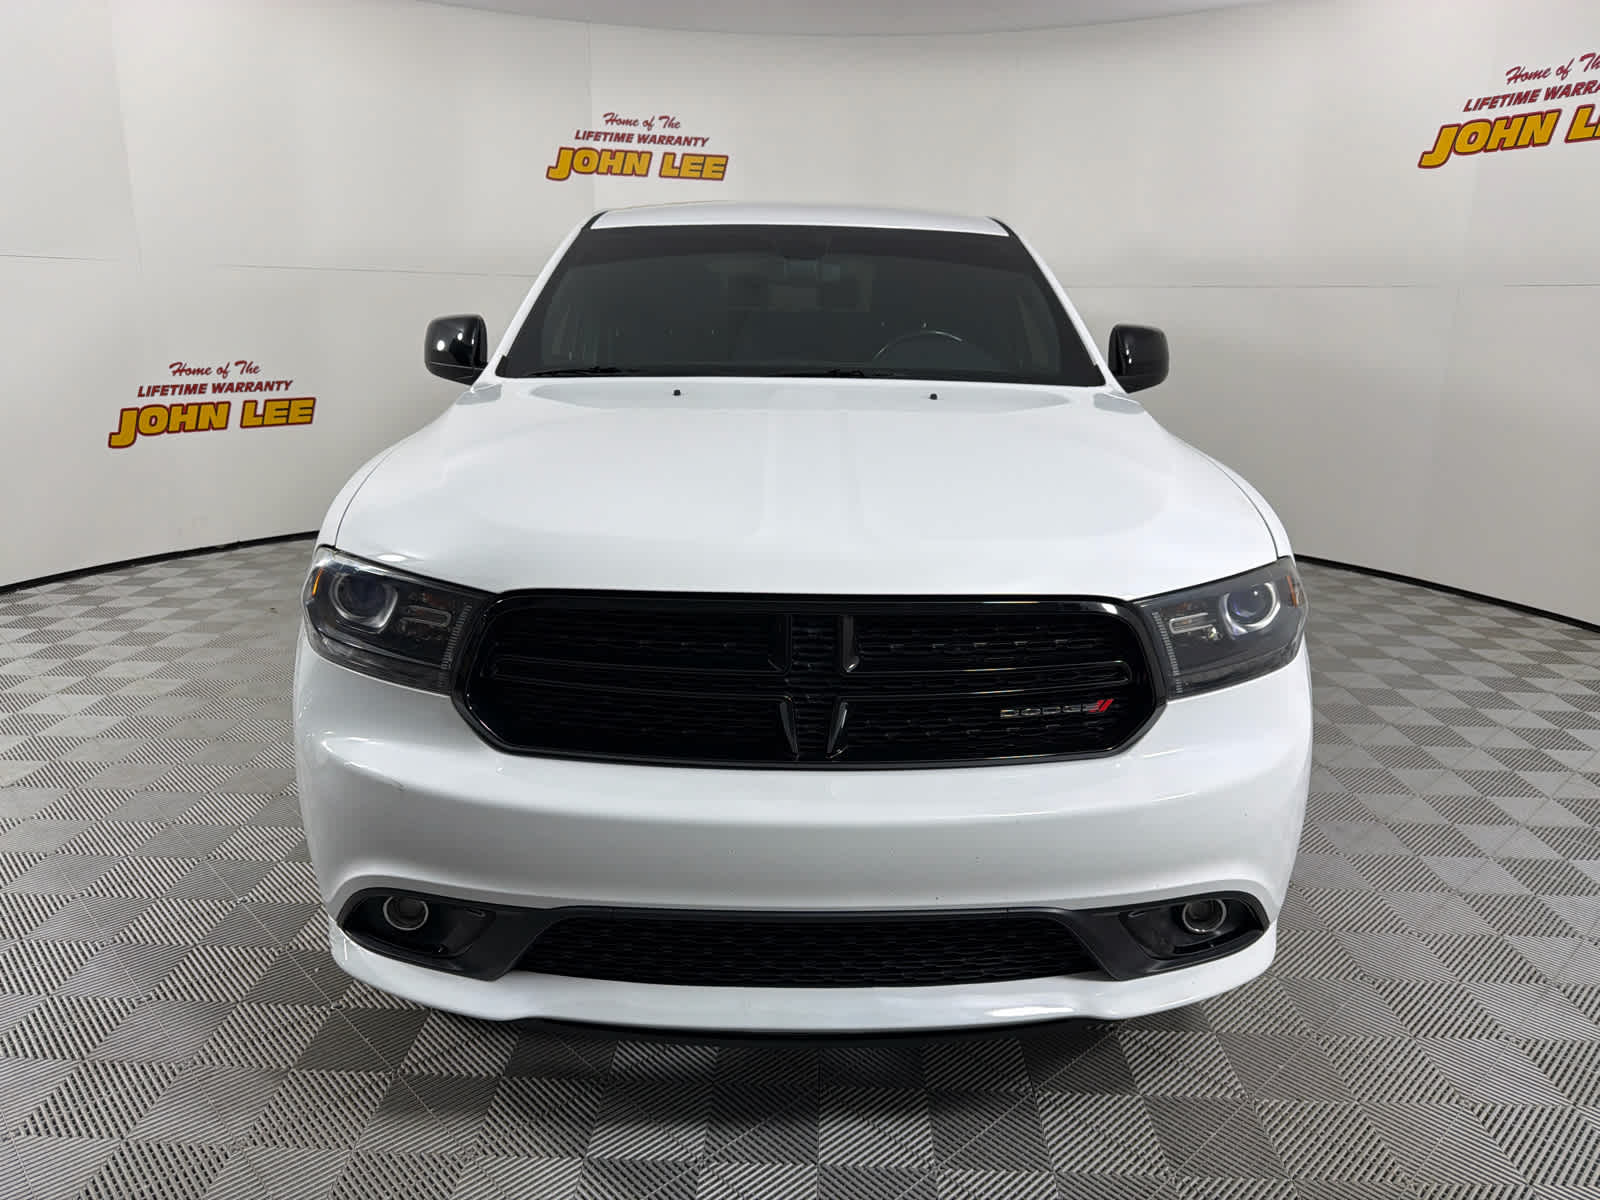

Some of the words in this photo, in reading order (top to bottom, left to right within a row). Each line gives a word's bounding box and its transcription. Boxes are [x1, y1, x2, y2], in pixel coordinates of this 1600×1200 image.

[1505, 66, 1551, 85] Home
[1556, 58, 1575, 80] of
[1463, 89, 1542, 112] LIFETIME
[603, 112, 639, 127] Home
[642, 117, 654, 131] of
[658, 115, 681, 129] The
[574, 130, 635, 143] LIFETIME
[637, 134, 710, 147] WARRANTY
[1418, 108, 1562, 168] JOHN
[1564, 104, 1600, 143] L
[546, 147, 652, 181] JOHN
[659, 152, 729, 181] LEE
[169, 362, 212, 376] Home
[216, 363, 230, 379] of
[234, 360, 261, 375] The
[137, 383, 208, 398] LIFETIME
[211, 380, 293, 394] WARRANTY
[108, 401, 231, 448] JOHN
[240, 397, 316, 428] LEE
[999, 703, 1099, 719] DODGE
